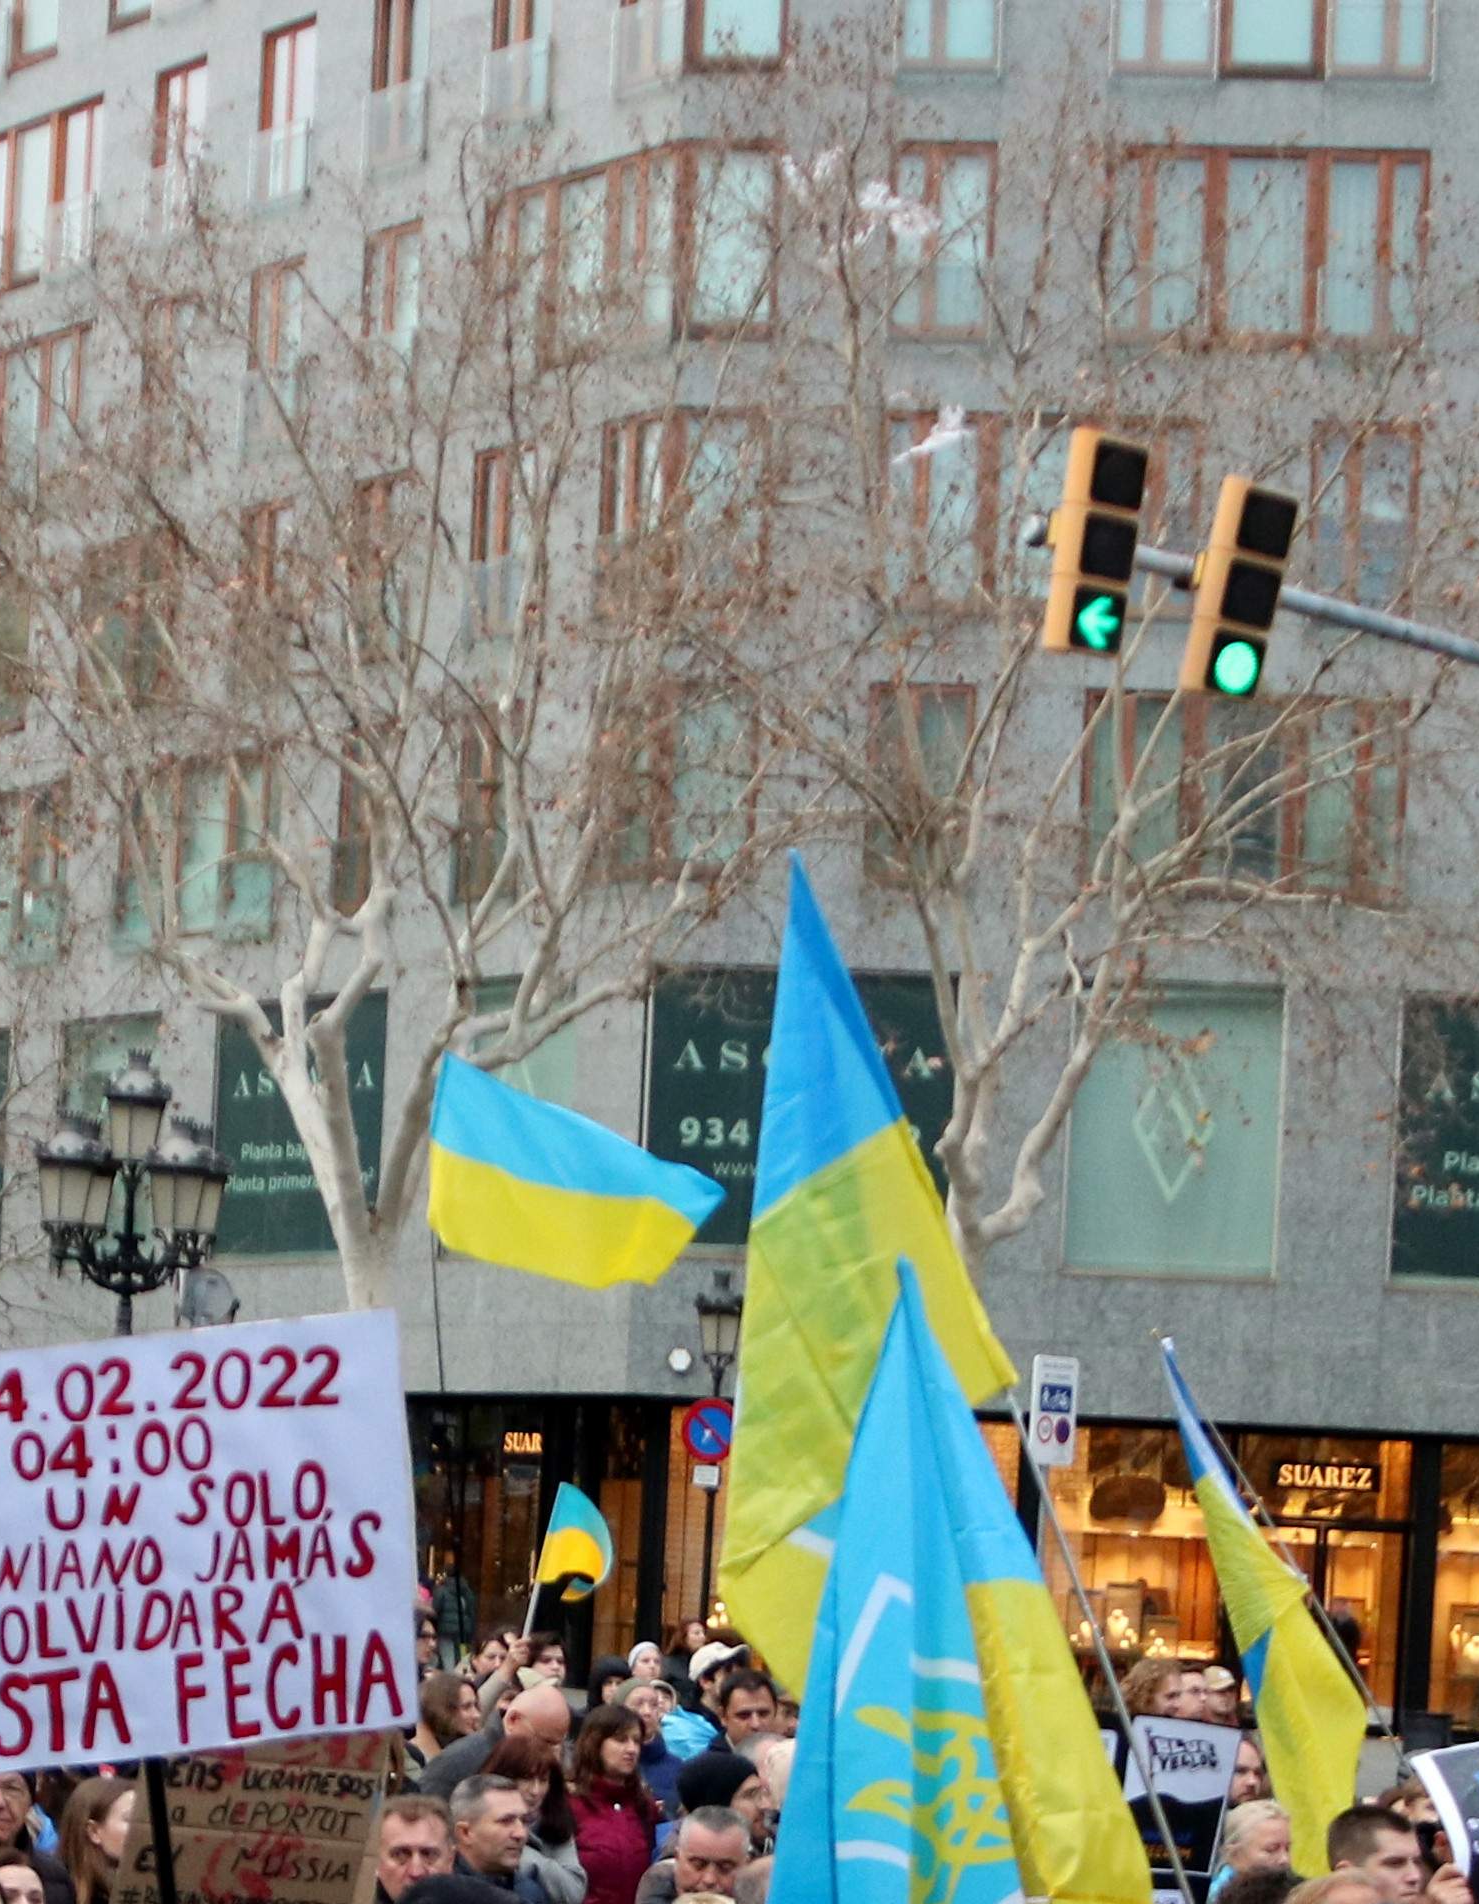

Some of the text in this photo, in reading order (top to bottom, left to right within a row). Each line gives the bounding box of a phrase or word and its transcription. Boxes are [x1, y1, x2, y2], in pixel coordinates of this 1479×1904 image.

[241, 1140, 308, 1162] Planta baj
[12, 1415, 213, 1482] 04:00
[503, 1432, 542, 1452] SUAR
[1276, 1463, 1373, 1490] SUAREZ
[46, 1484, 141, 1532] UN
[195, 1507, 382, 1586] JAMÁS
[175, 1629, 403, 1746] FECHA
